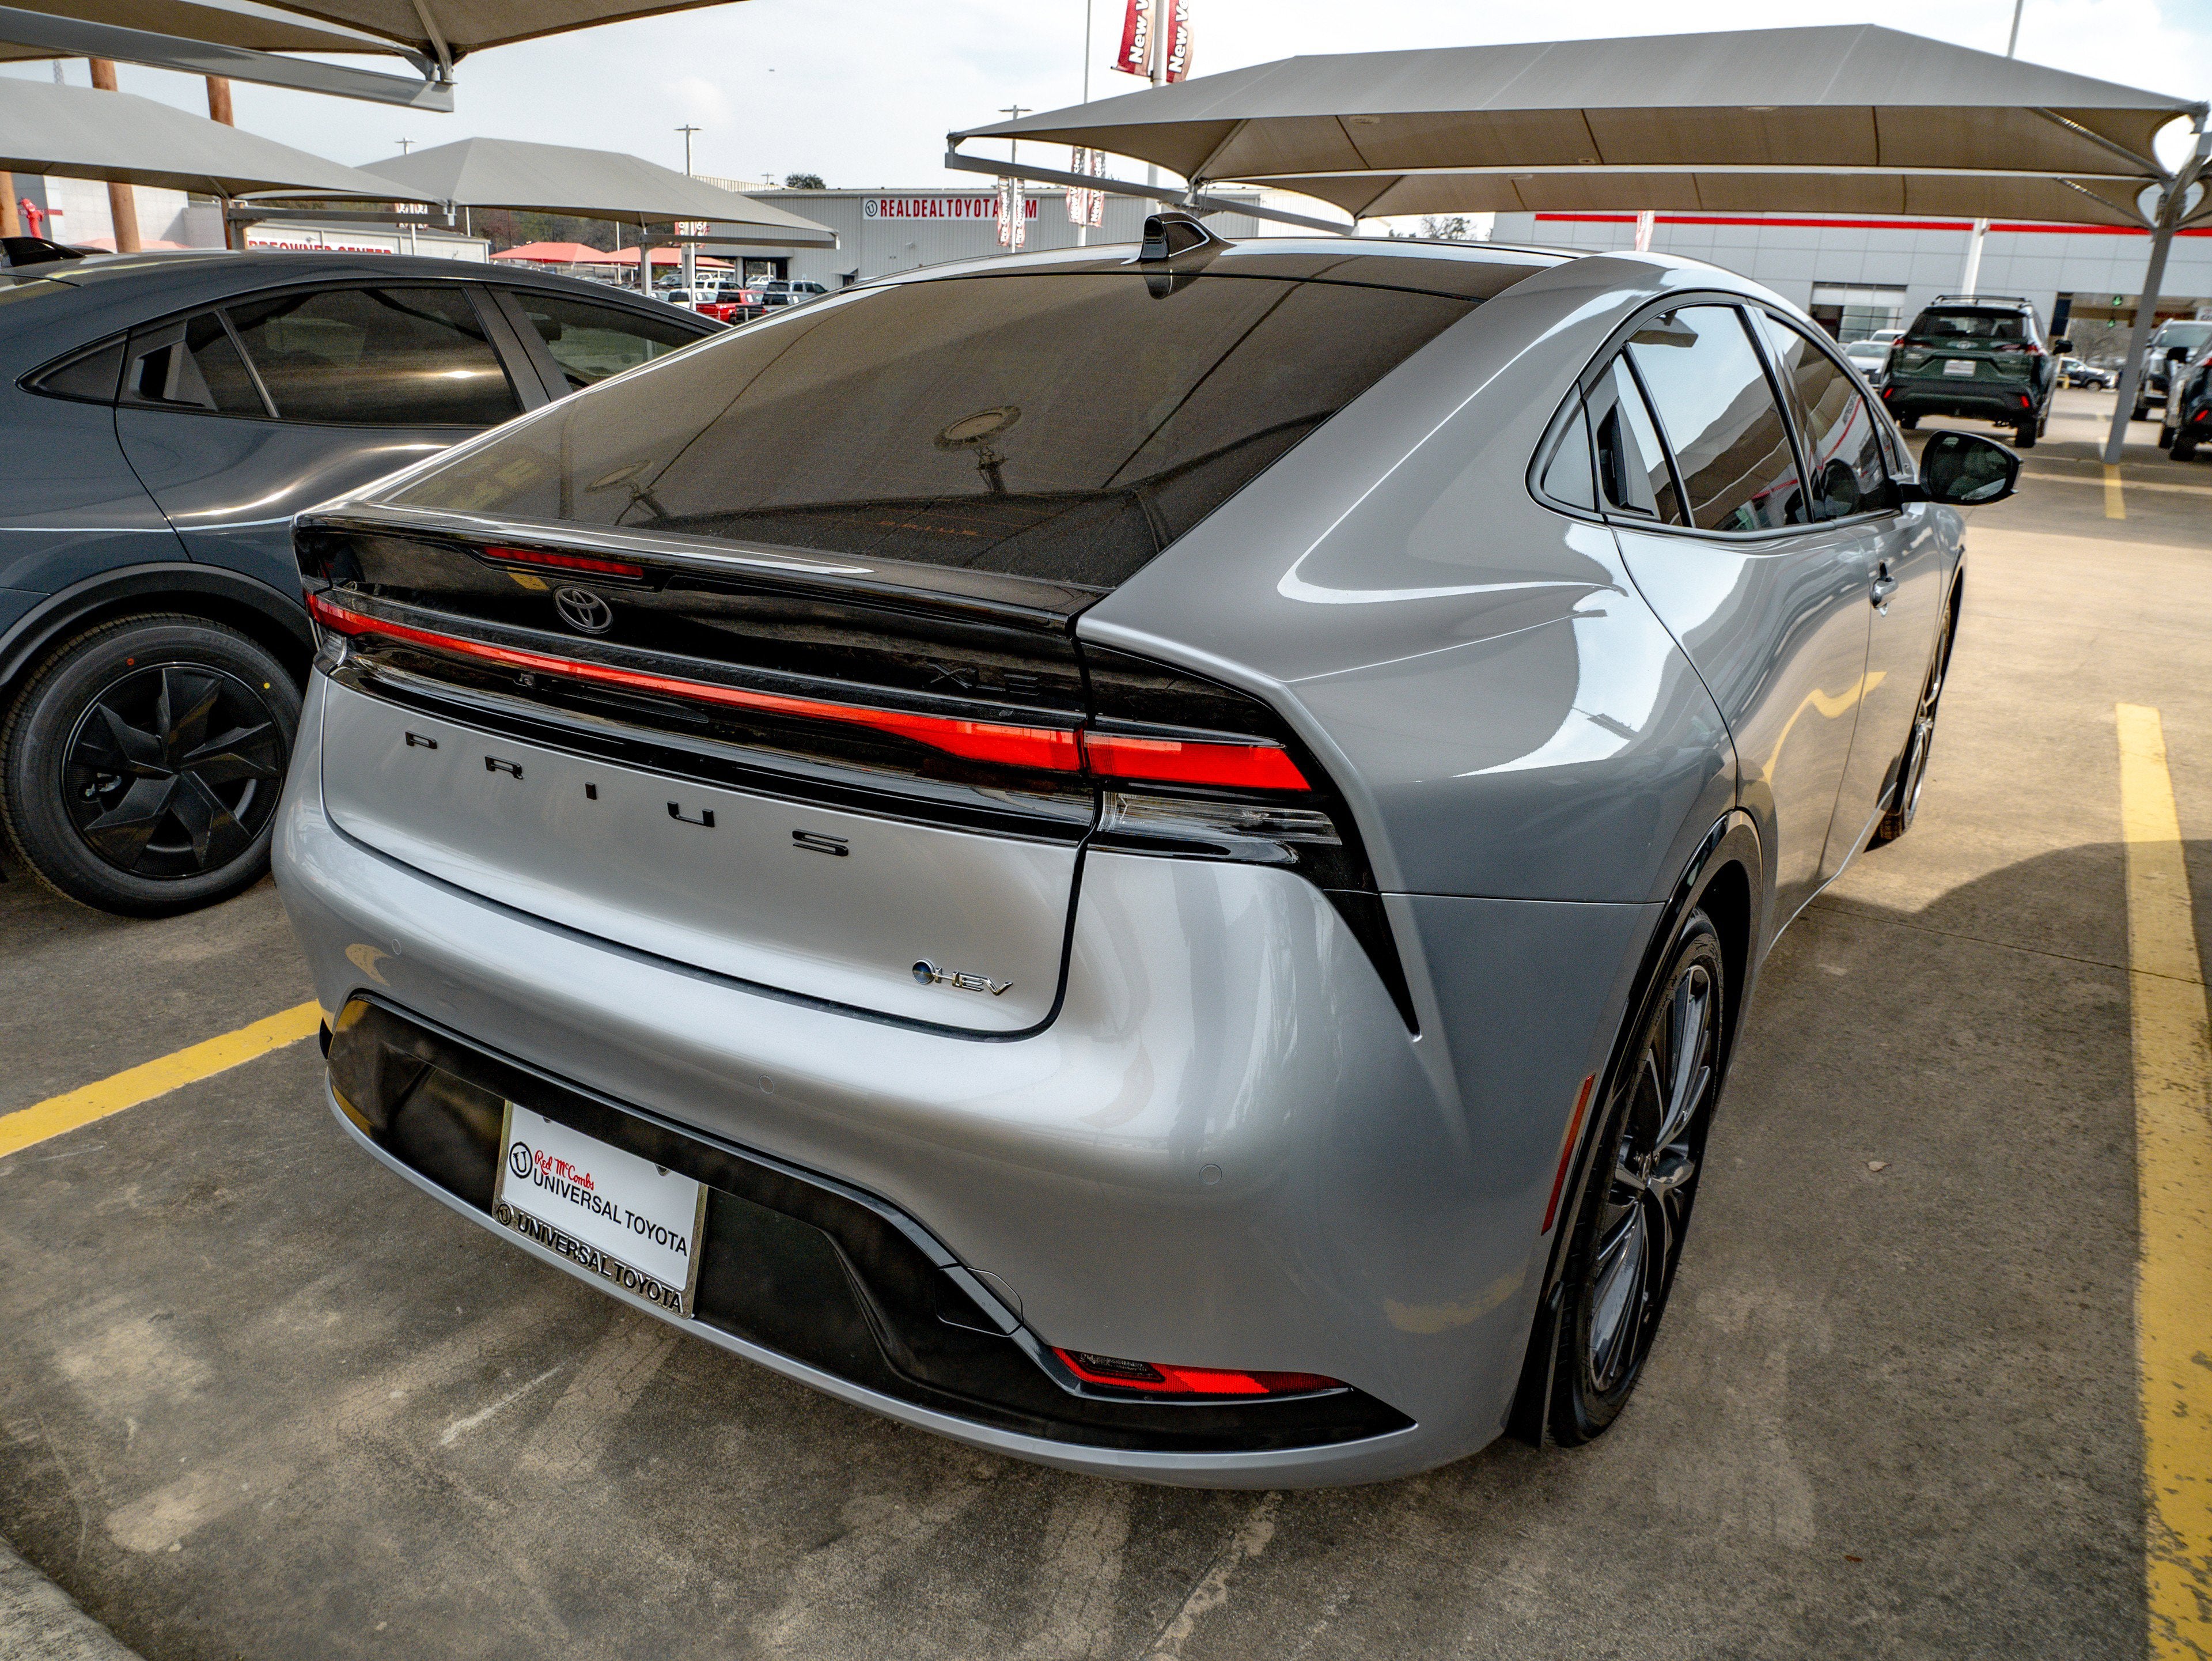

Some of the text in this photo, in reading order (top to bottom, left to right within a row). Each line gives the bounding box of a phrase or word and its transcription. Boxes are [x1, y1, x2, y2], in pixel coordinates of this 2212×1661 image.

[1128, 15, 1147, 64] New
[1168, 26, 1187, 73] New
[1070, 196, 1078, 220] New
[1090, 199, 1100, 222] New
[927, 663, 1040, 696] XLE
[405, 731, 849, 857] PRIUS
[934, 967, 1013, 996] HEV
[535, 1150, 594, 1191] Red McCombs
[533, 1168, 688, 1257] UNIVERSAL TOYOTA
[518, 1212, 611, 1277] UNIVERSAL
[614, 1261, 684, 1314] TOYOTA
